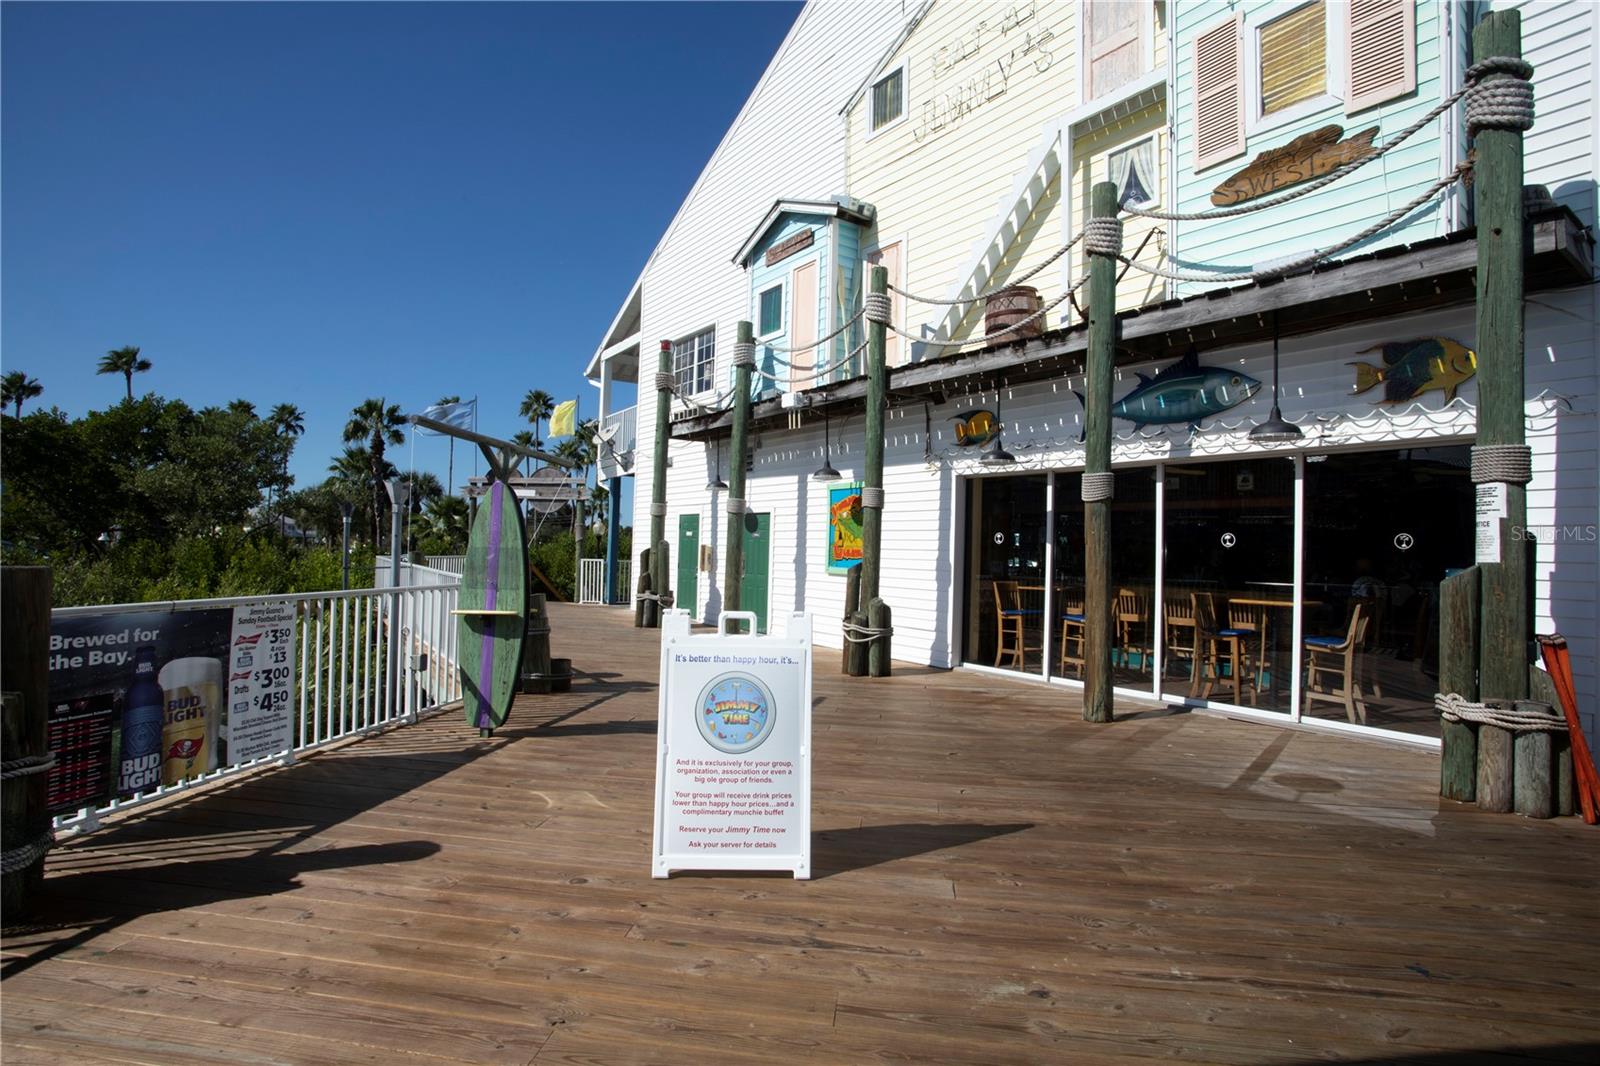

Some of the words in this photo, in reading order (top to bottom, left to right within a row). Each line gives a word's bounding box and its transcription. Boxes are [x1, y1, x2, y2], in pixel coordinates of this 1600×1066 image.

[1249, 150, 1322, 197] WEST
[50, 629, 128, 650] Brewed
[133, 628, 160, 642] for
[49, 654, 83, 670] the
[88, 650, 132, 666] Bay.
[675, 654, 687, 662] It's
[689, 654, 712, 663] better
[714, 655, 731, 663] than
[733, 656, 757, 665] happy
[759, 656, 779, 664] hour,
[168, 696, 200, 712] BUD
[715, 700, 761, 714] JIMMY
[167, 706, 206, 724] IGHT
[723, 713, 750, 725] TIME
[122, 753, 160, 775] BUD
[726, 826, 750, 834] Jimmy
